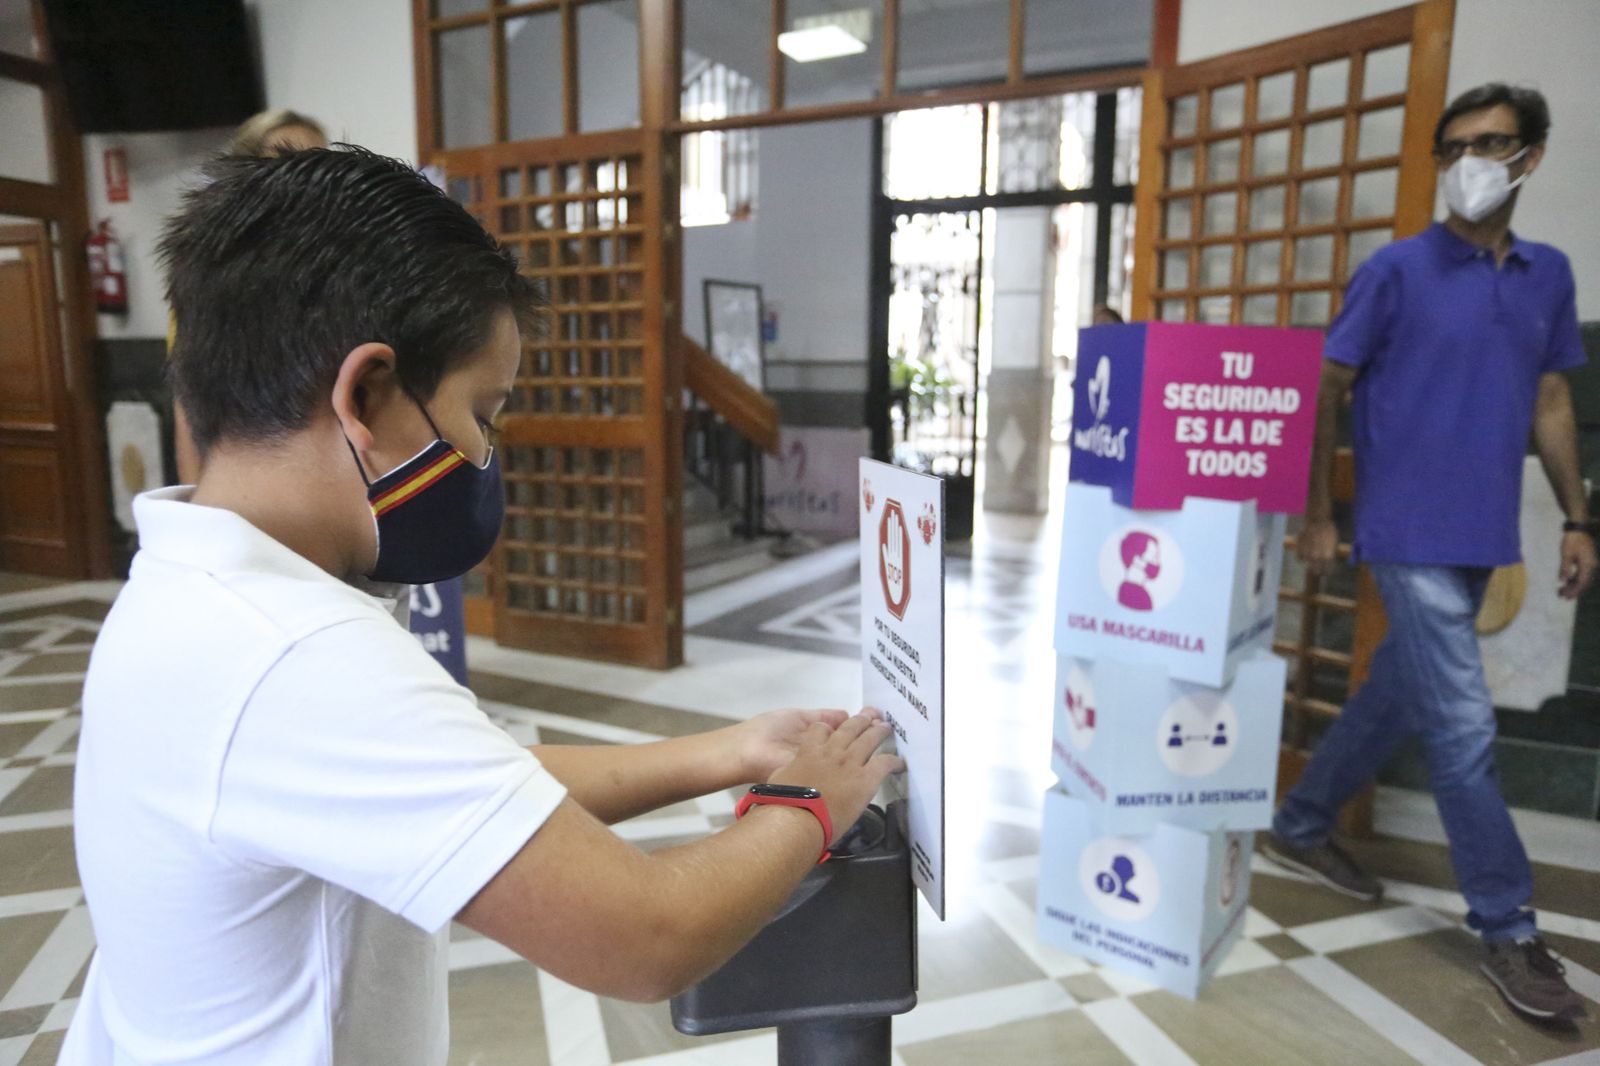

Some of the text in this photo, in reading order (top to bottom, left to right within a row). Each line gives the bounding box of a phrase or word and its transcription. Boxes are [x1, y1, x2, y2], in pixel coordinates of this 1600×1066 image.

[1221, 351, 1254, 379] TU
[1163, 382, 1300, 414] SEGURIDAD
[1176, 416, 1284, 446] ES LA DE
[1185, 449, 1268, 478] TODOS
[887, 562, 902, 586] STOP
[1067, 613, 1097, 633] USA
[1102, 618, 1205, 654] MASCARILLA
[1115, 788, 1268, 807] MANTEN LA DISTANCIA
